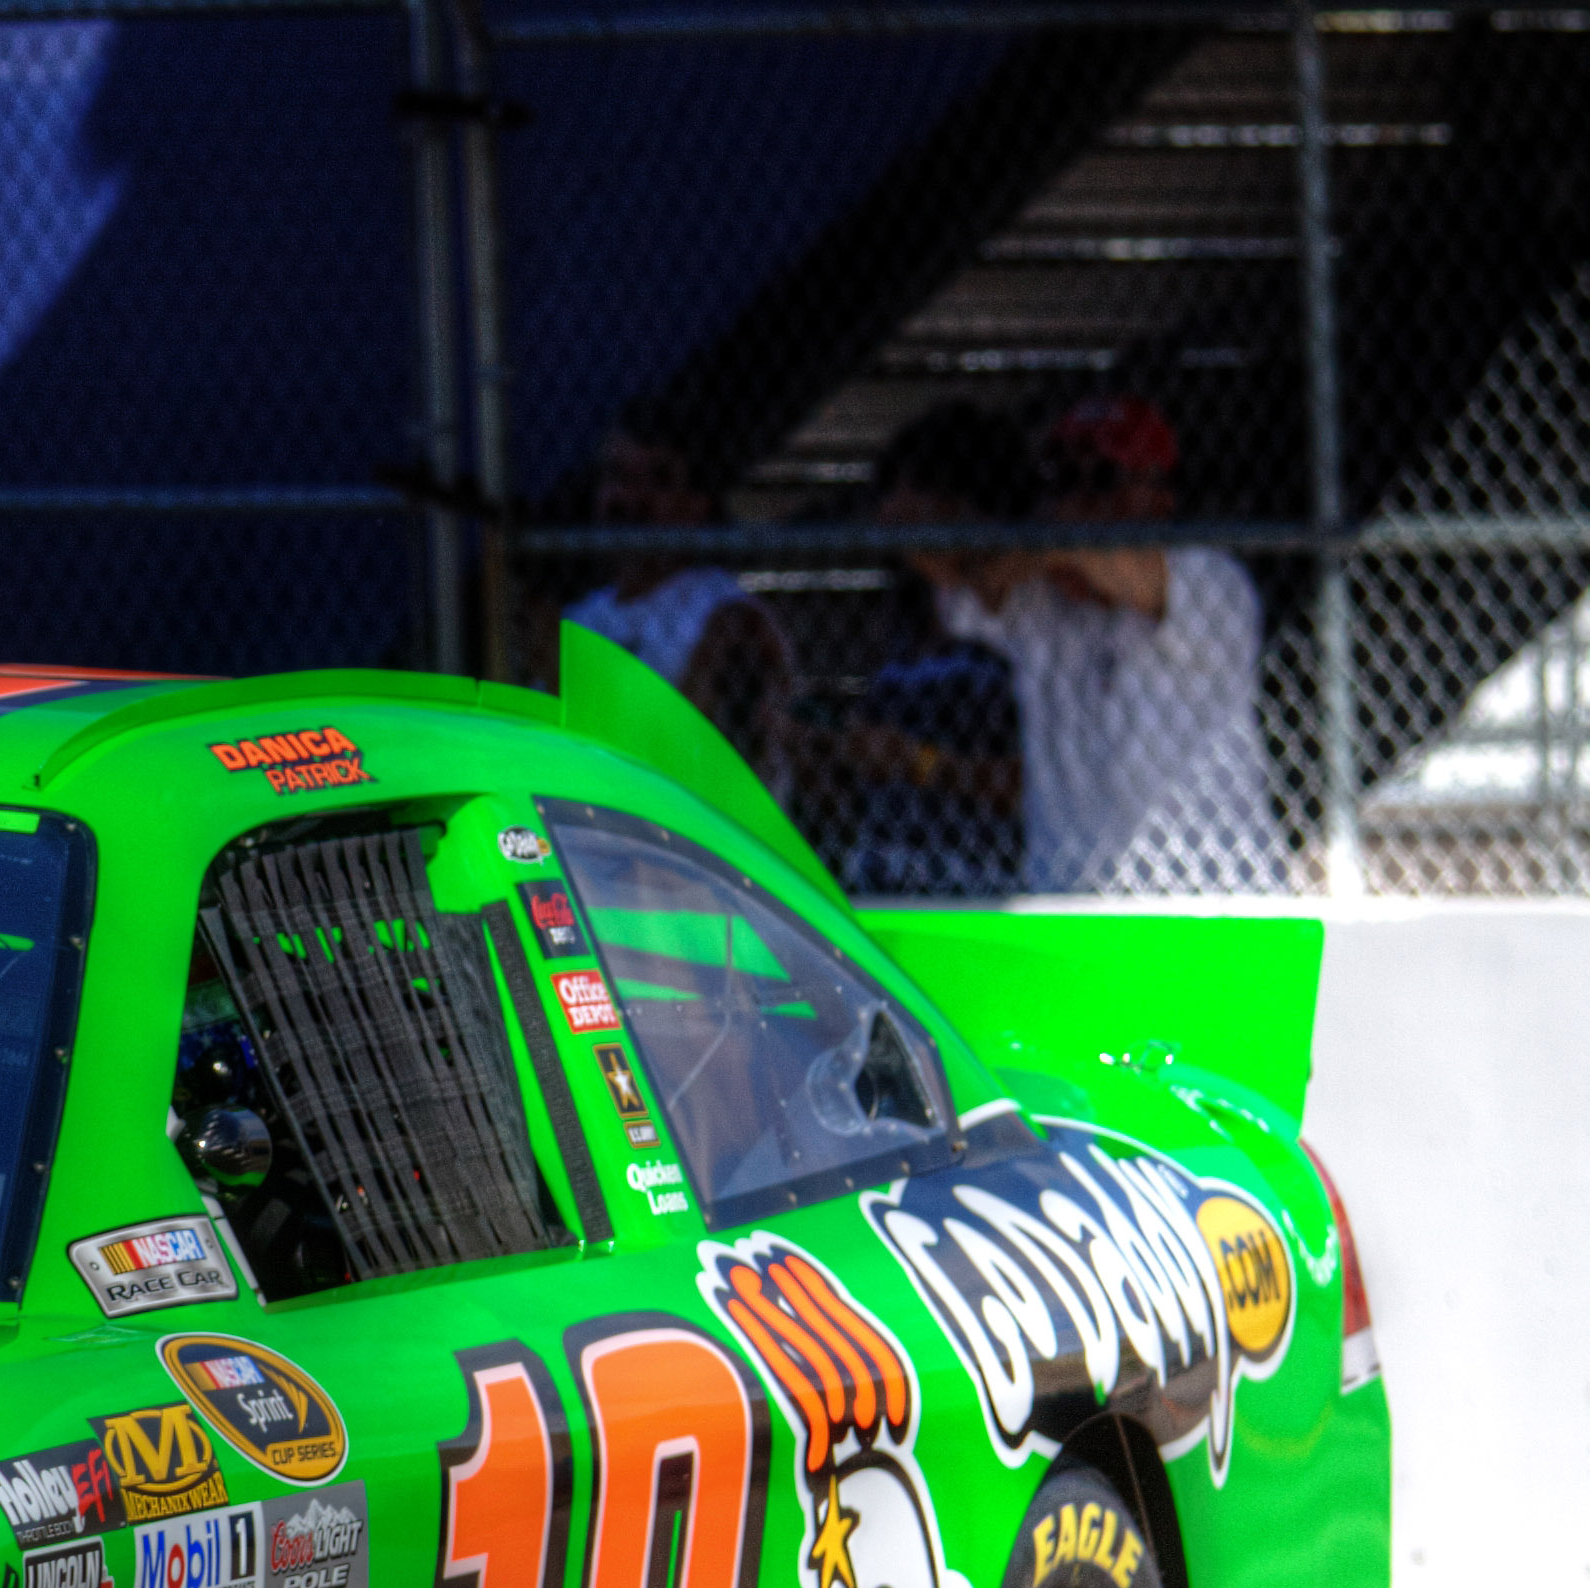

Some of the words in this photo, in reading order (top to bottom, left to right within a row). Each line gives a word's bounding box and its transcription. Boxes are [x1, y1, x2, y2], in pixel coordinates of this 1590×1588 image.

[209, 726, 357, 771] DANICA
[265, 757, 371, 794] PATRICK
[559, 975, 609, 1005] Office
[568, 1003, 616, 1028] DEPOT
[626, 1160, 683, 1192] Quicken
[647, 1190, 689, 1216] Loans
[134, 1229, 205, 1264] NASCAR
[105, 1277, 174, 1302] RACE
[178, 1268, 221, 1288] CAR
[237, 1389, 294, 1433] Sprint
[272, 1447, 295, 1466] CUP
[297, 1441, 337, 1462] SERIES
[121, 1487, 196, 1522] MECHANIX
[187, 1470, 229, 1512] WEAR
[234, 1517, 248, 1578] 1
[269, 1519, 314, 1573] Coors
[314, 1520, 364, 1563] LIGHT
